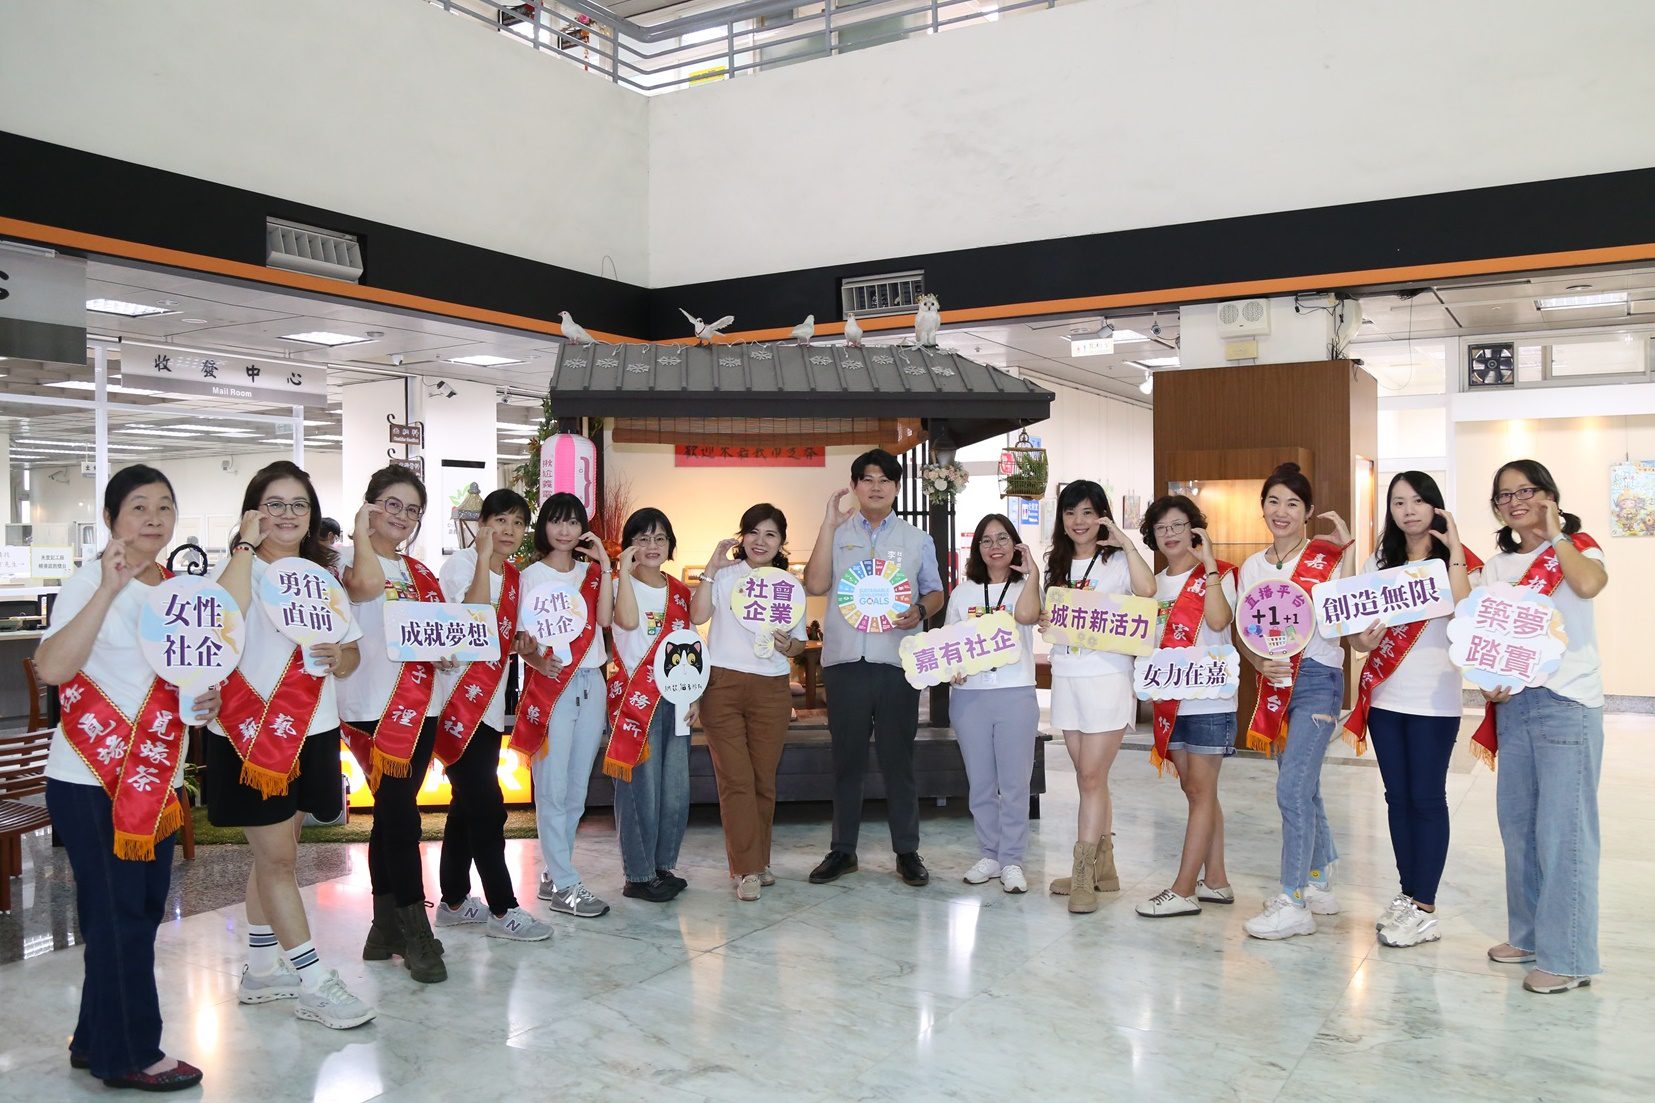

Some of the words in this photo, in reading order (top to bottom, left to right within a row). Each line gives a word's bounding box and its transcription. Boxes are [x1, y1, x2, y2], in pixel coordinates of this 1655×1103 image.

[154, 354, 303, 386] 收發中心
[212, 386, 229, 395] Mail
[230, 388, 253, 398] Room
[278, 568, 330, 602] 勇往
[745, 576, 796, 601] 社會
[1244, 584, 1306, 611] 直播平台
[162, 593, 224, 630] 女性
[533, 591, 571, 616] 女性
[743, 600, 794, 625] 企業
[859, 597, 890, 605] GOALS
[1252, 605, 1281, 626] +1
[1283, 613, 1300, 625] +1
[1322, 576, 1441, 625] 創造無限
[282, 601, 333, 633] 直前
[537, 615, 575, 639] 社企
[1050, 603, 1150, 640] 城市新活力
[1475, 596, 1549, 636] 築夢
[400, 620, 490, 648] 成就夢想
[163, 633, 223, 668] 社企
[912, 625, 1017, 675] 嘉有社企
[1465, 634, 1537, 679] 踏實
[1143, 660, 1227, 688] 女力在嘉
